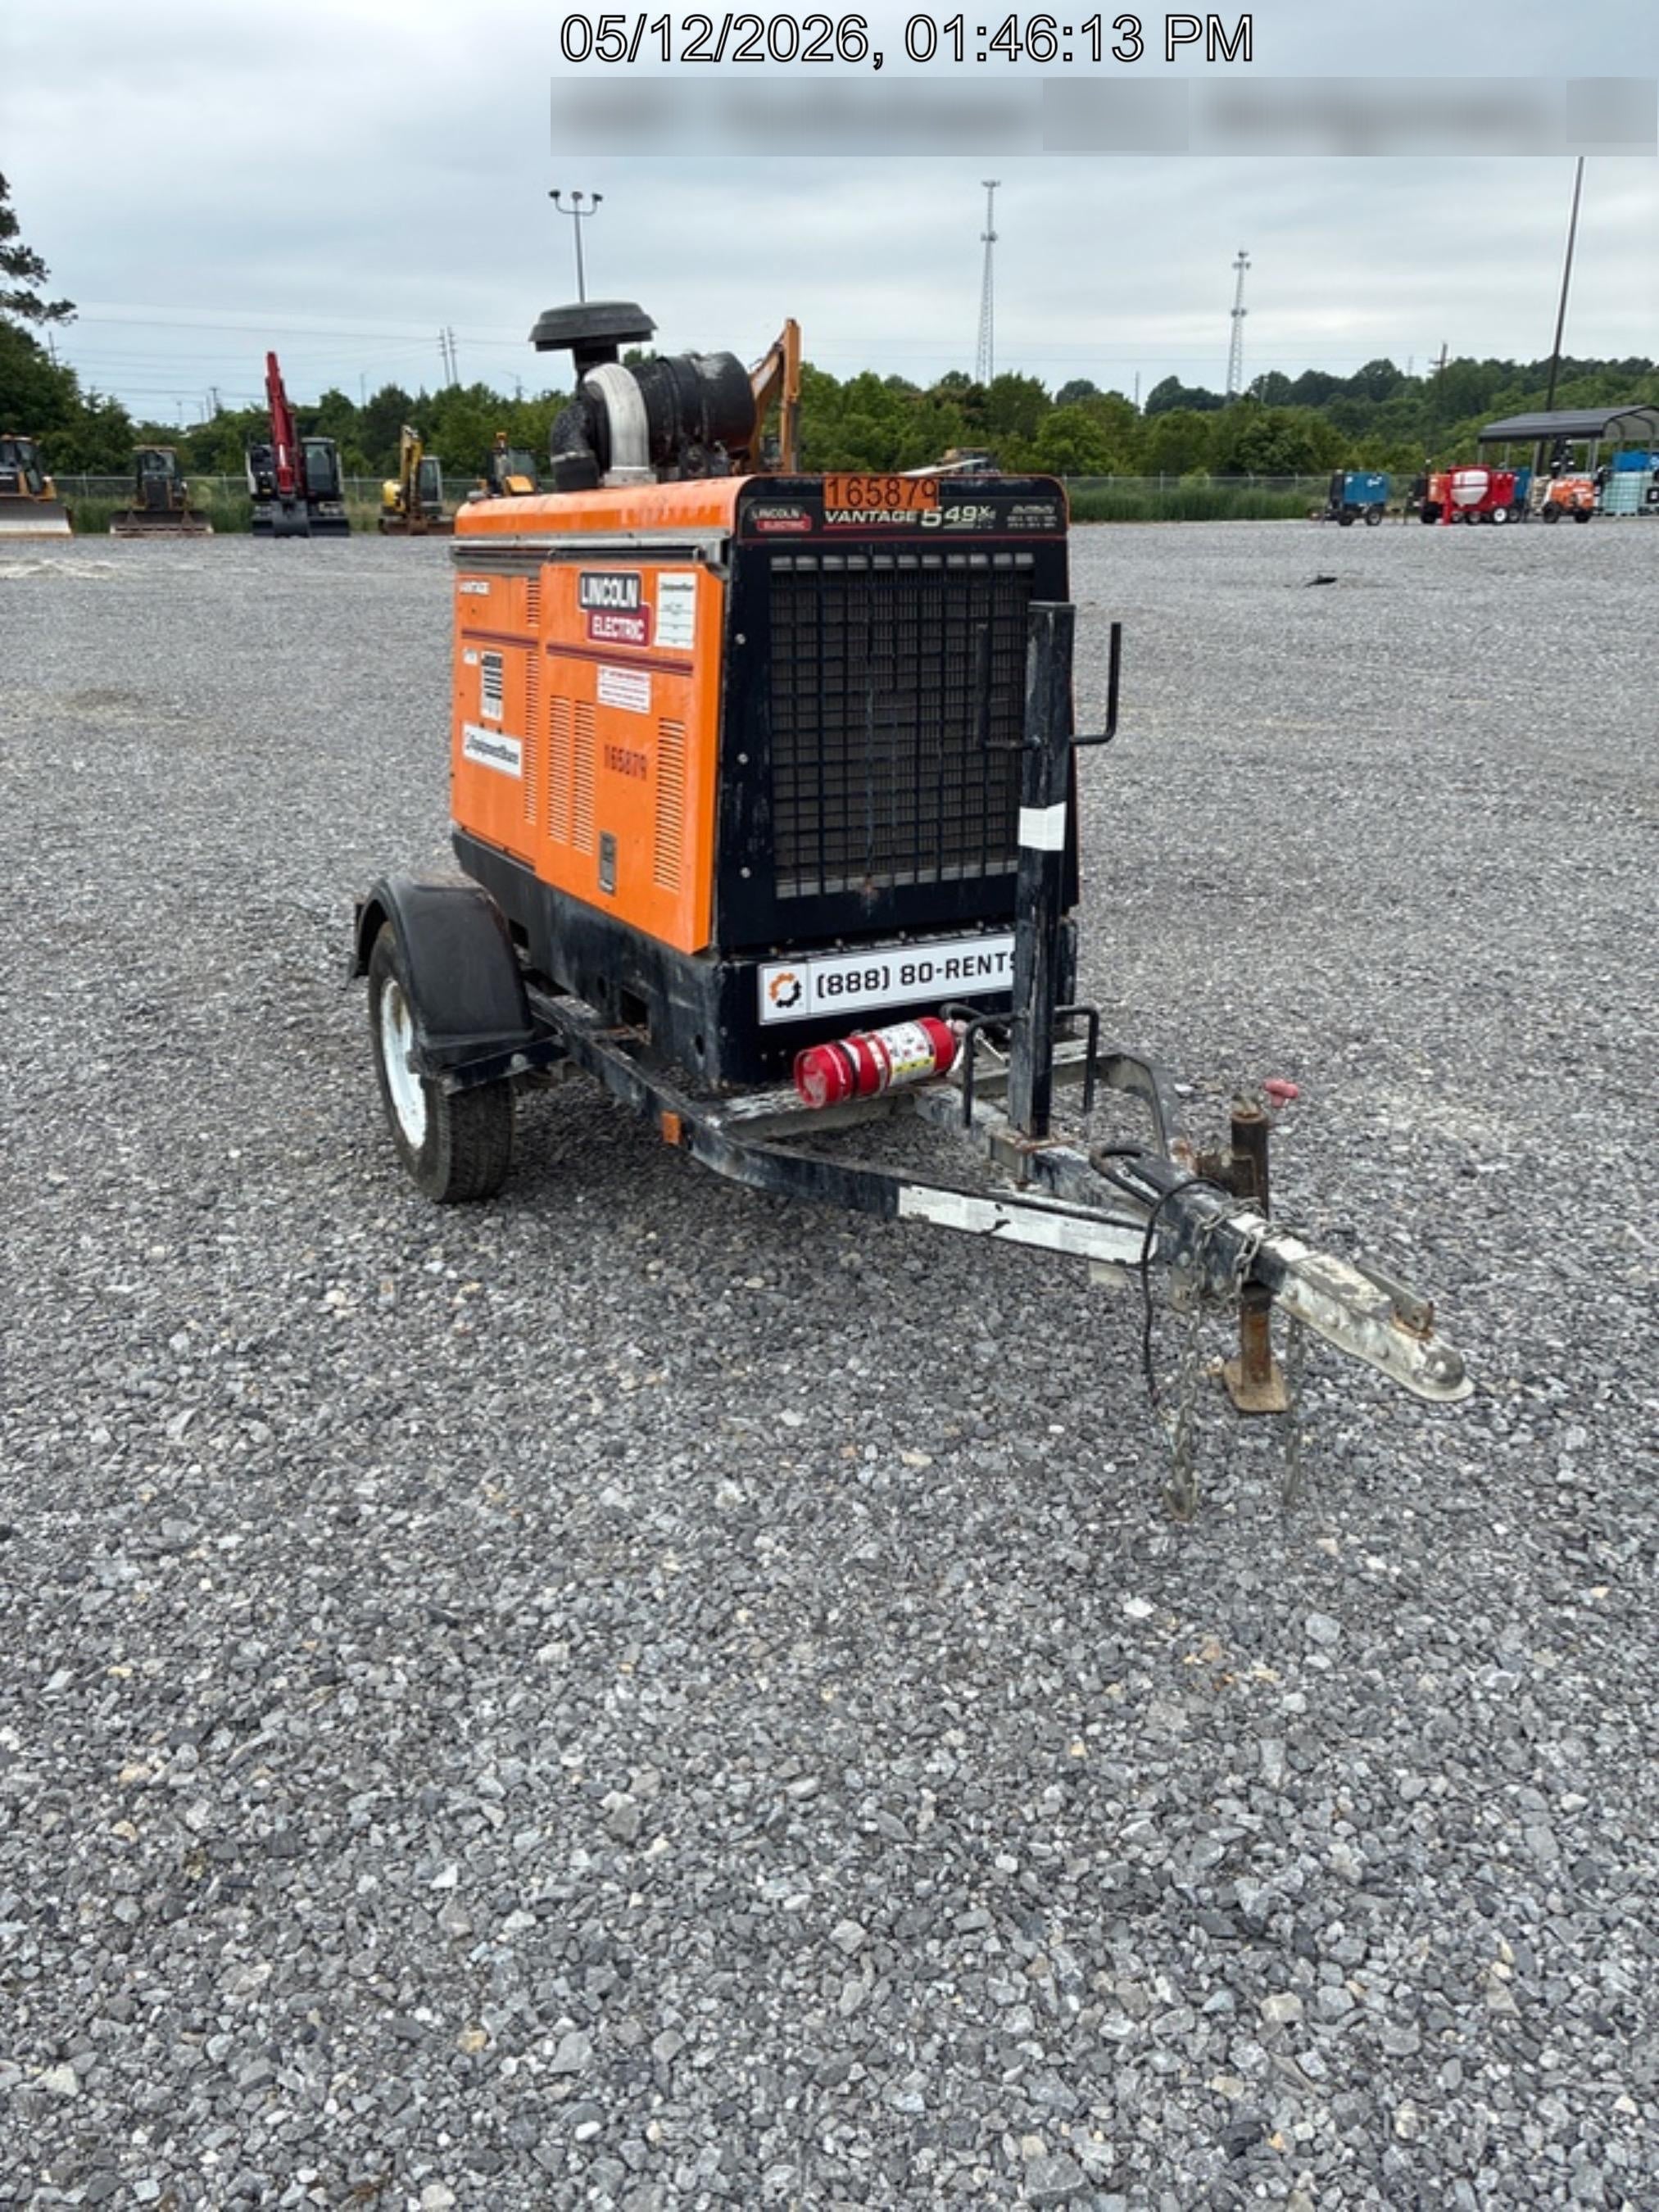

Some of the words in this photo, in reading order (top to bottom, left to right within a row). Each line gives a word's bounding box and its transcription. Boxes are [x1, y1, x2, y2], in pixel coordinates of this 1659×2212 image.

[827, 477, 938, 507] 165879
[751, 508, 800, 519] LINCOLN
[824, 510, 916, 523] VANTAGE
[581, 577, 637, 609] LINCOLN
[592, 614, 645, 641] ELECTRIC
[817, 965, 891, 999] (888)
